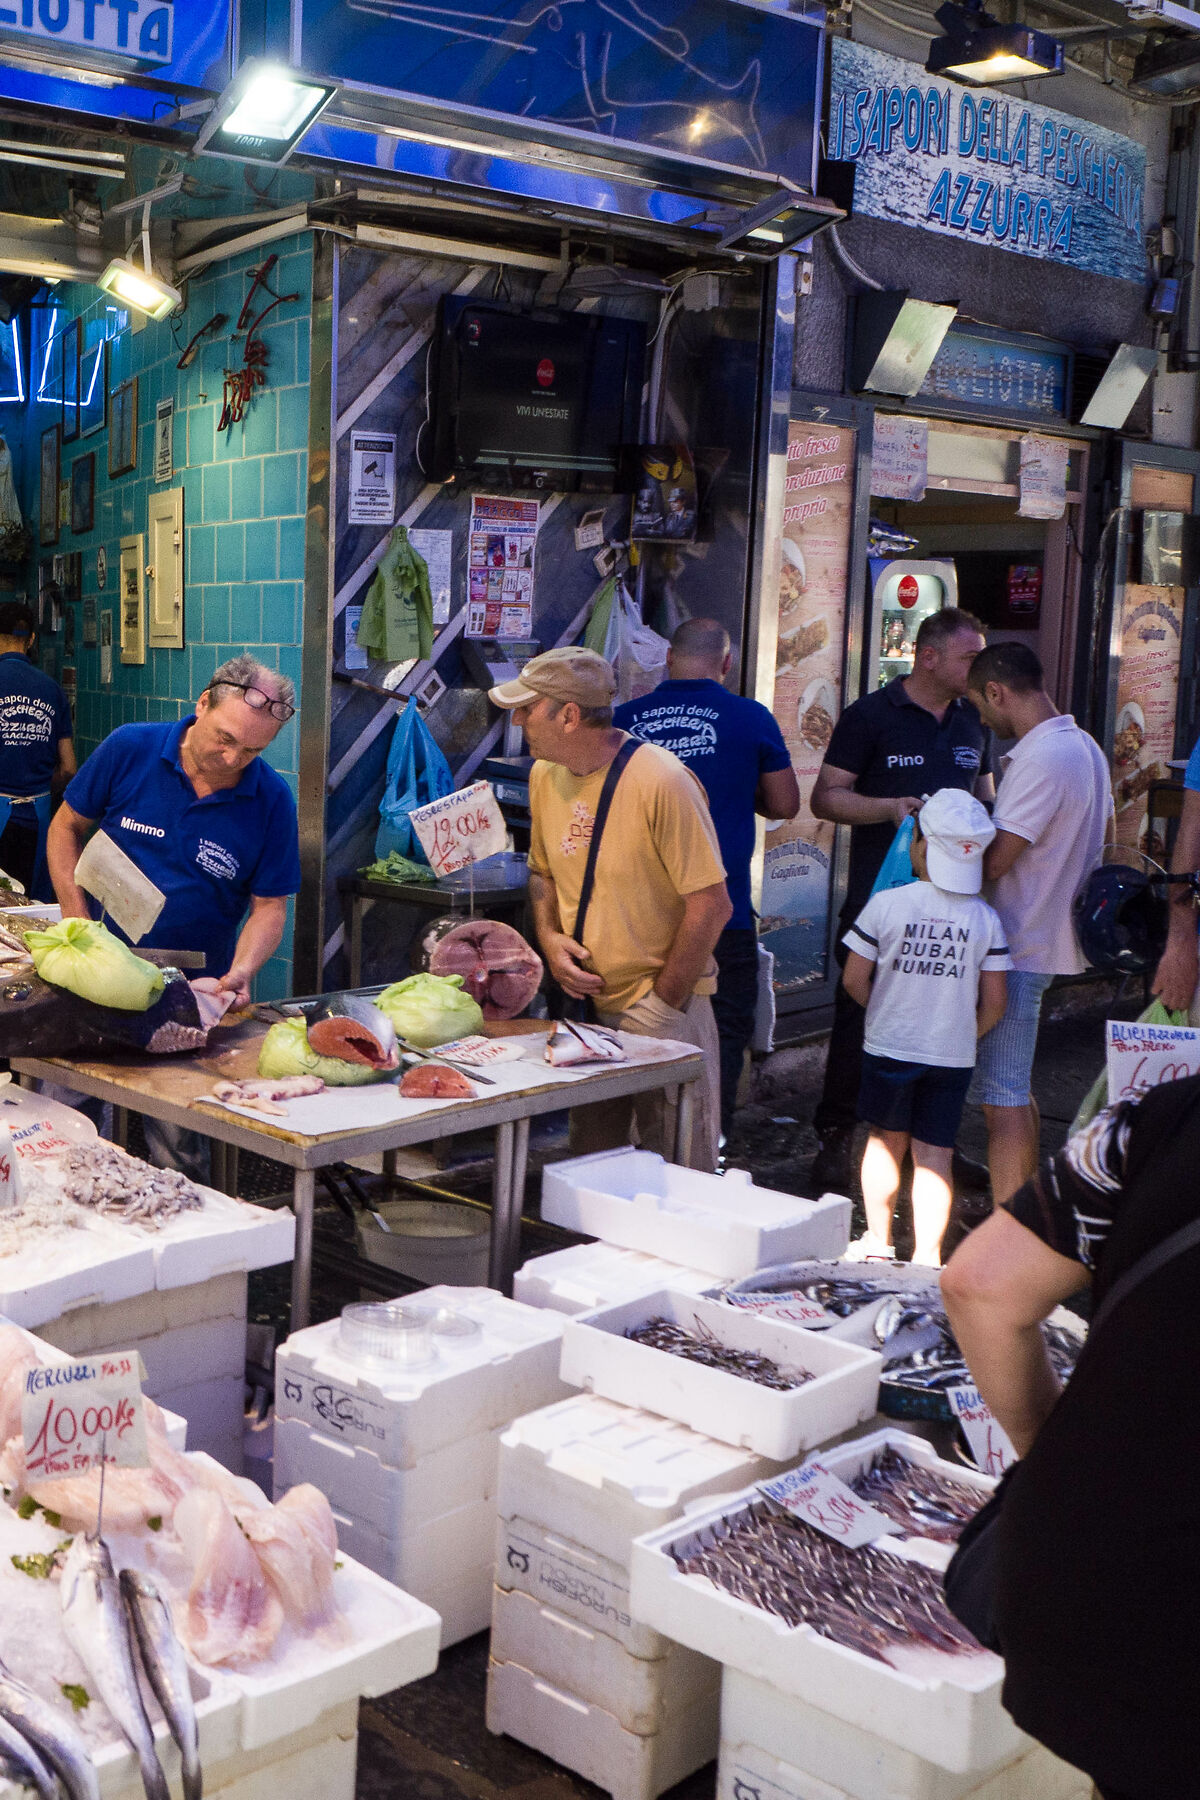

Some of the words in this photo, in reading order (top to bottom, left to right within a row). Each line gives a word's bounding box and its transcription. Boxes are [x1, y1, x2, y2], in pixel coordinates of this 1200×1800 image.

[850, 85, 951, 159] SAPORI
[958, 91, 1030, 172] DELLA
[1039, 119, 1143, 244] PESCHERIA
[926, 168, 1075, 253] AZZURRA
[804, 435, 840, 456] fresco
[784, 496, 827, 526] propria
[642, 704, 684, 719] sapori
[686, 705, 719, 720] della
[887, 754, 924, 768] Pino
[120, 816, 166, 838] Mimmo
[904, 924, 970, 942] MILAN
[901, 941, 965, 961] DUBAI
